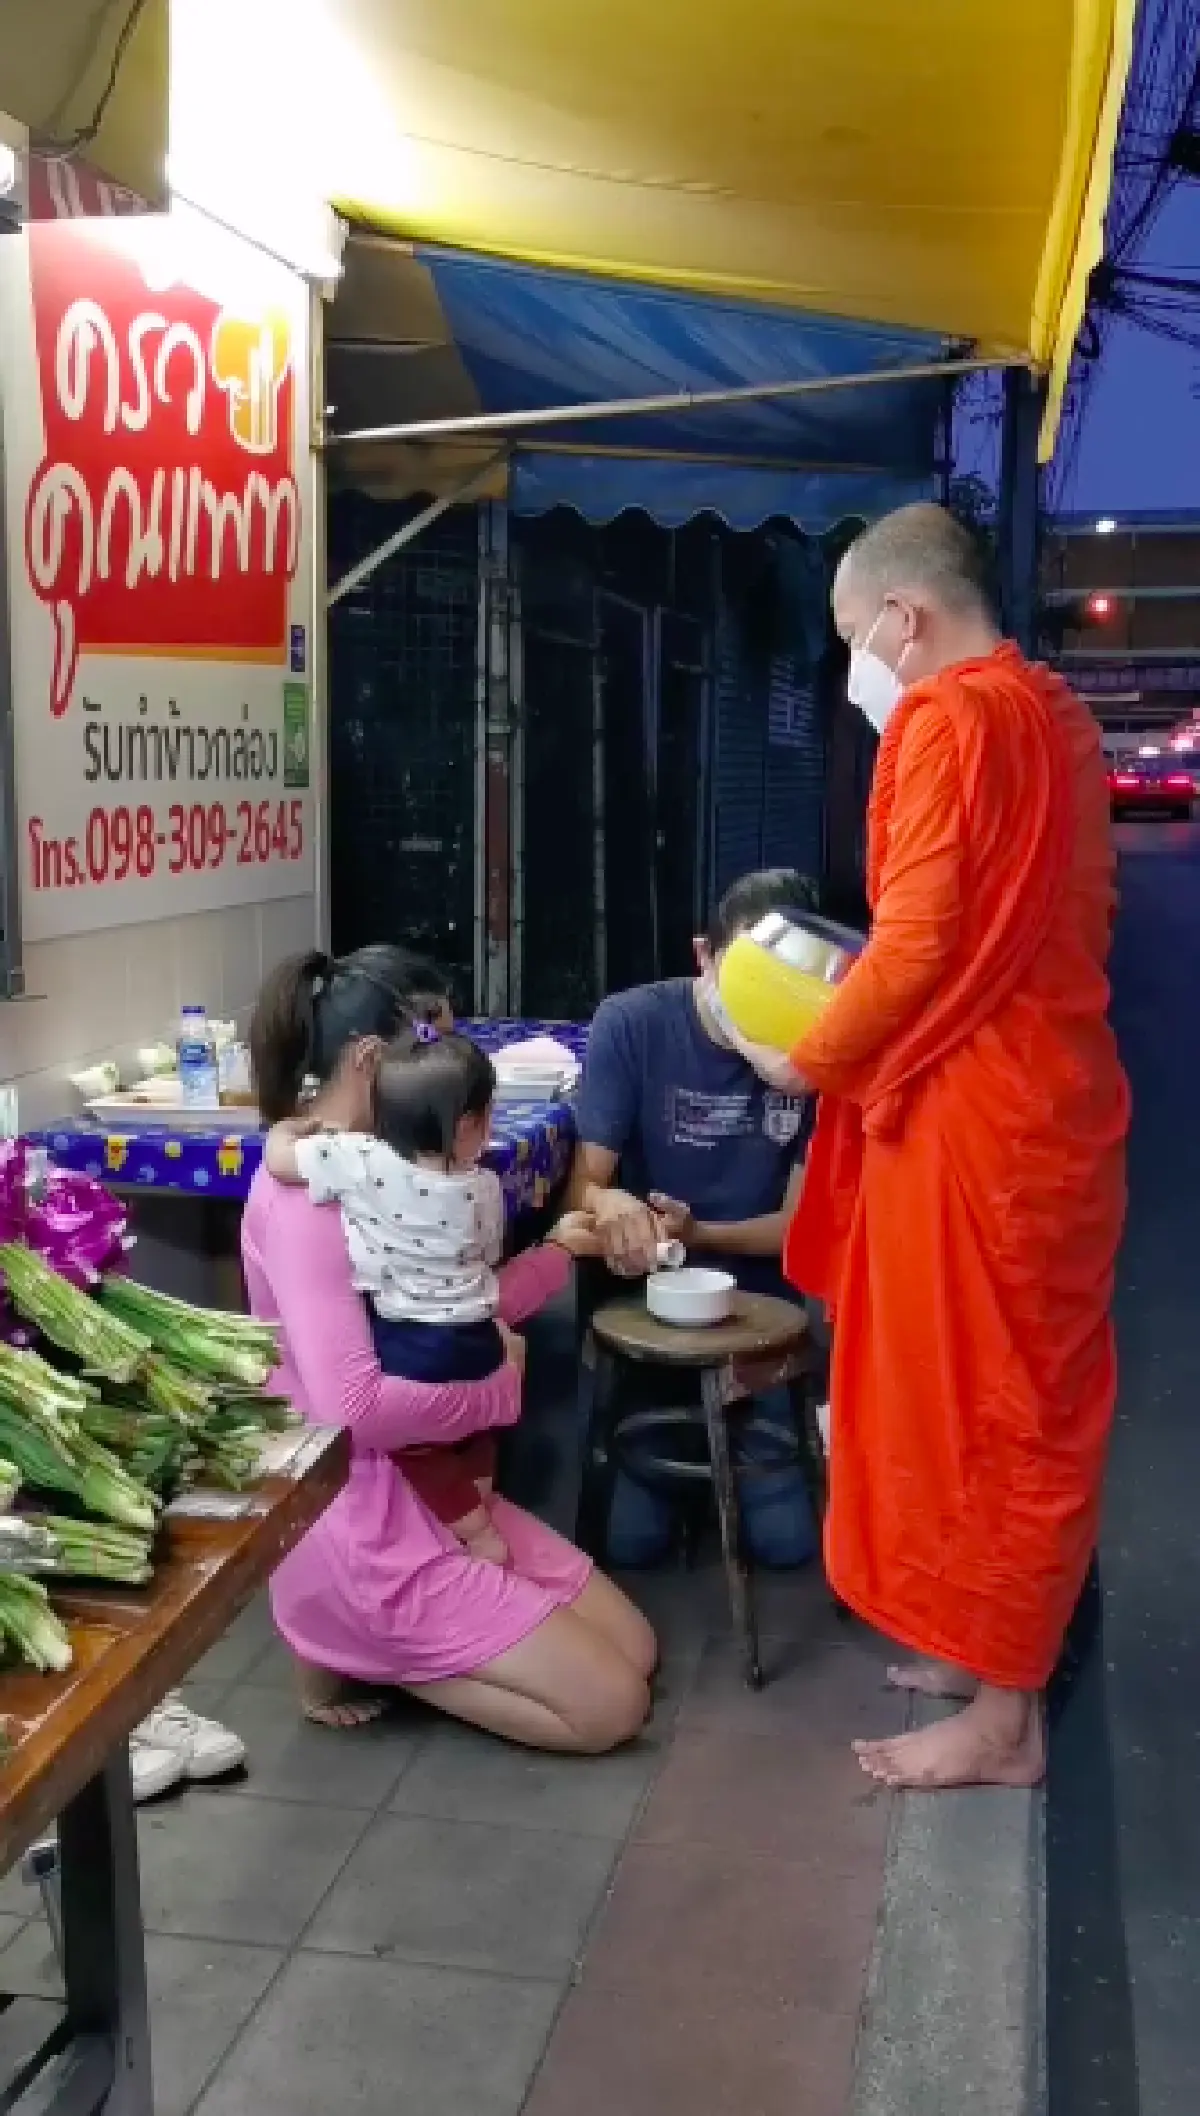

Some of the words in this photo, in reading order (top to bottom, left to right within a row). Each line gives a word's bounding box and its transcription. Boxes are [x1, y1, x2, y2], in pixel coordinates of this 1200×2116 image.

[55, 268, 206, 436] ครว
[83, 694, 278, 783] รับทำข้าวกล่อง
[27, 799, 304, 891] โทร.098-309-2645
